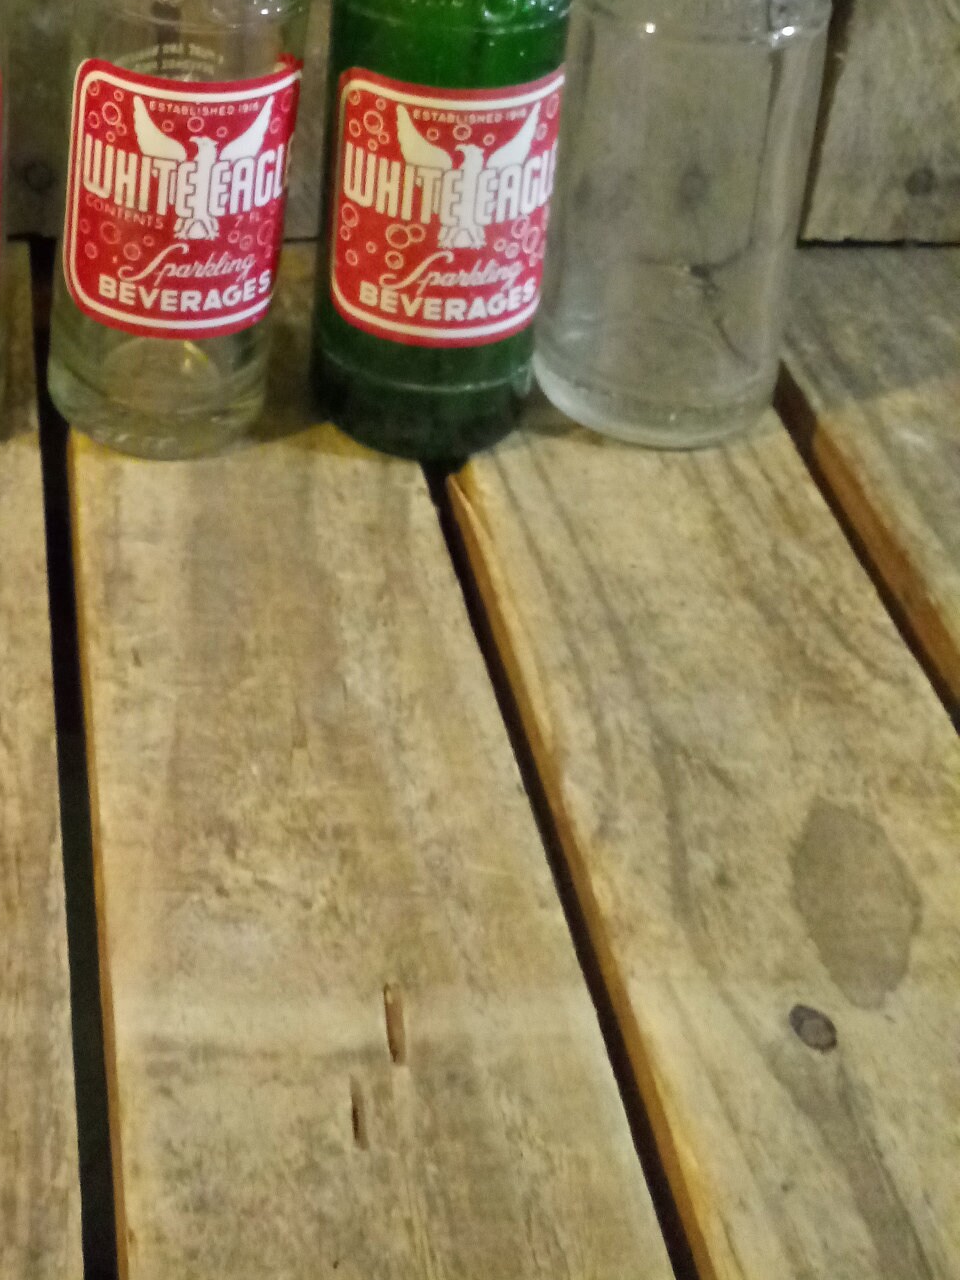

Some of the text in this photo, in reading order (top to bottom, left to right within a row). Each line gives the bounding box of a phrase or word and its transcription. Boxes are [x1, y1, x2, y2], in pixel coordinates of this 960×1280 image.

[149, 100, 235, 116] ESTABLISHED
[413, 108, 502, 125] ESTABLISHED
[83, 133, 286, 217] WHITE EAGL
[343, 141, 462, 225] WHITE
[86, 194, 164, 230] CONTENTS
[118, 242, 257, 286] Sparkling
[378, 250, 524, 295] Sparkling
[98, 269, 272, 313] BEVERAGES
[358, 277, 537, 322] BEVERAGES
